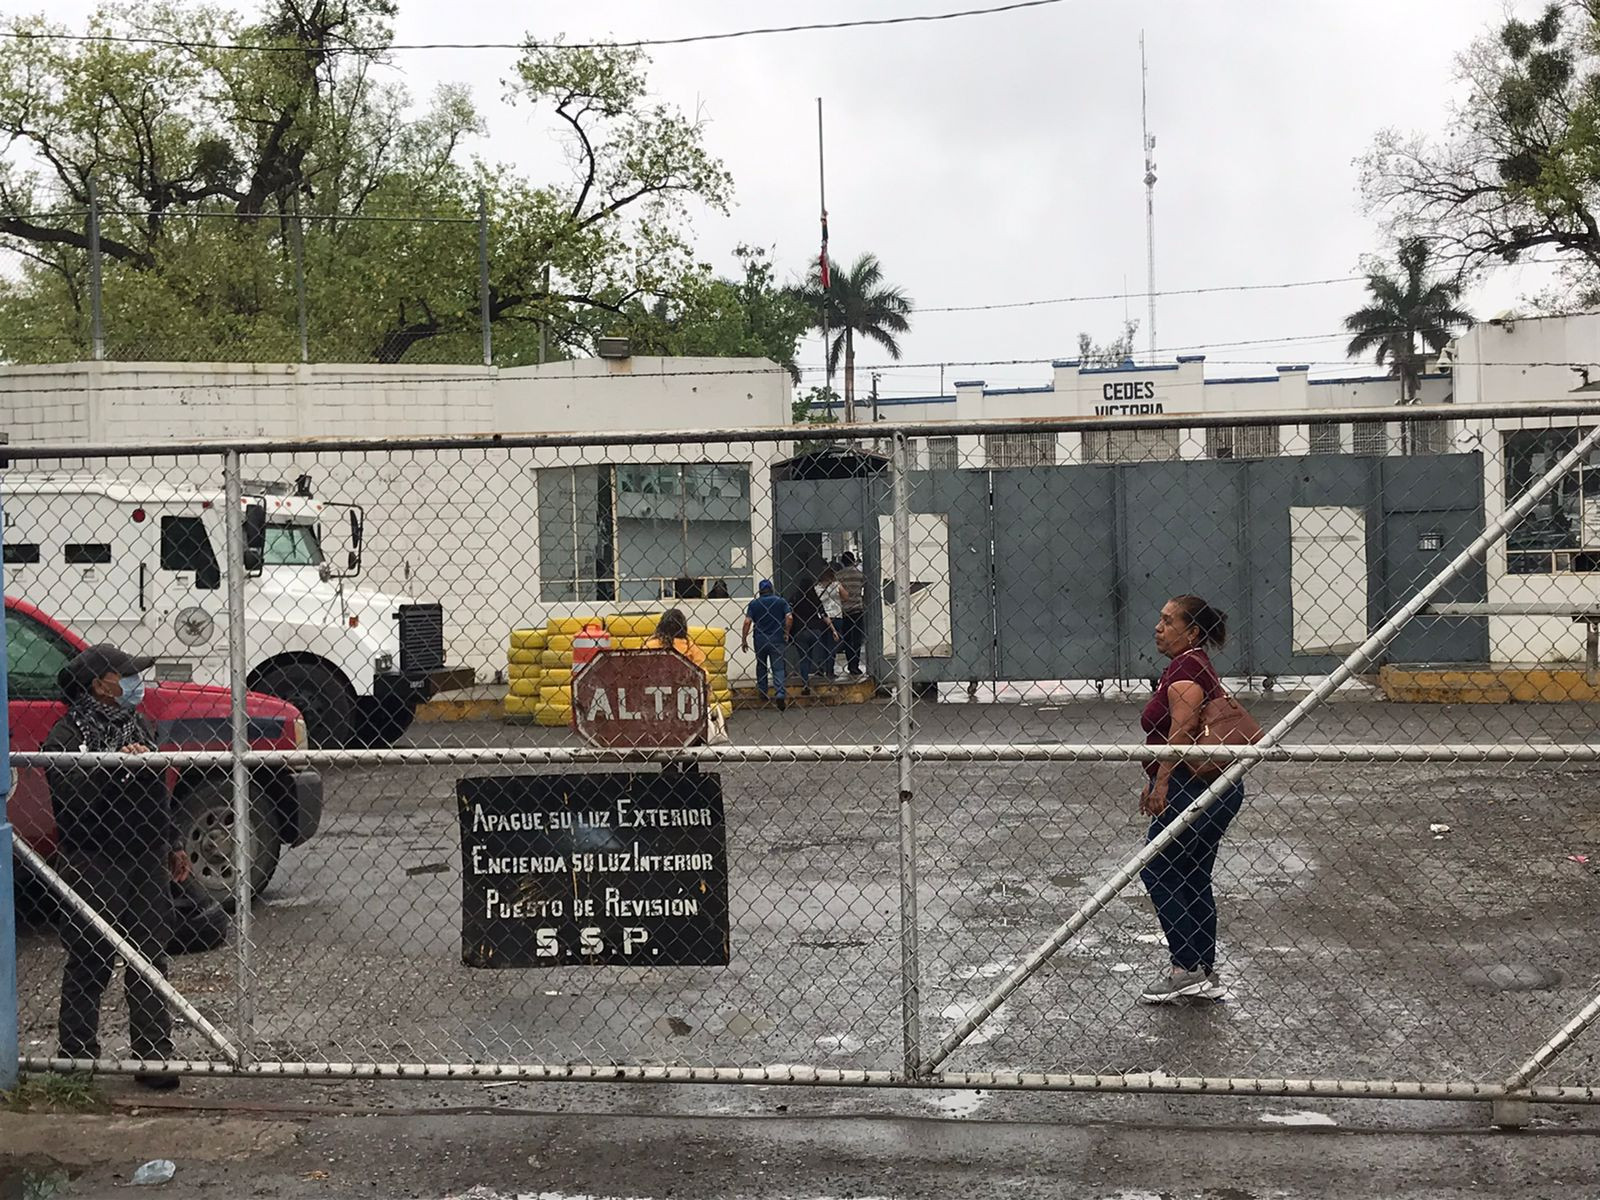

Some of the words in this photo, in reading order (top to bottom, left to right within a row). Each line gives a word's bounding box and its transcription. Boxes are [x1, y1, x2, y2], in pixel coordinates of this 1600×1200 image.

[1103, 381, 1154, 401] CEDES
[587, 687, 699, 721] ALTO
[550, 812, 572, 829] SU
[578, 811, 610, 828] LUZ
[572, 854, 593, 871] SU
[599, 853, 630, 871] LUZ
[574, 899, 594, 917] DE
